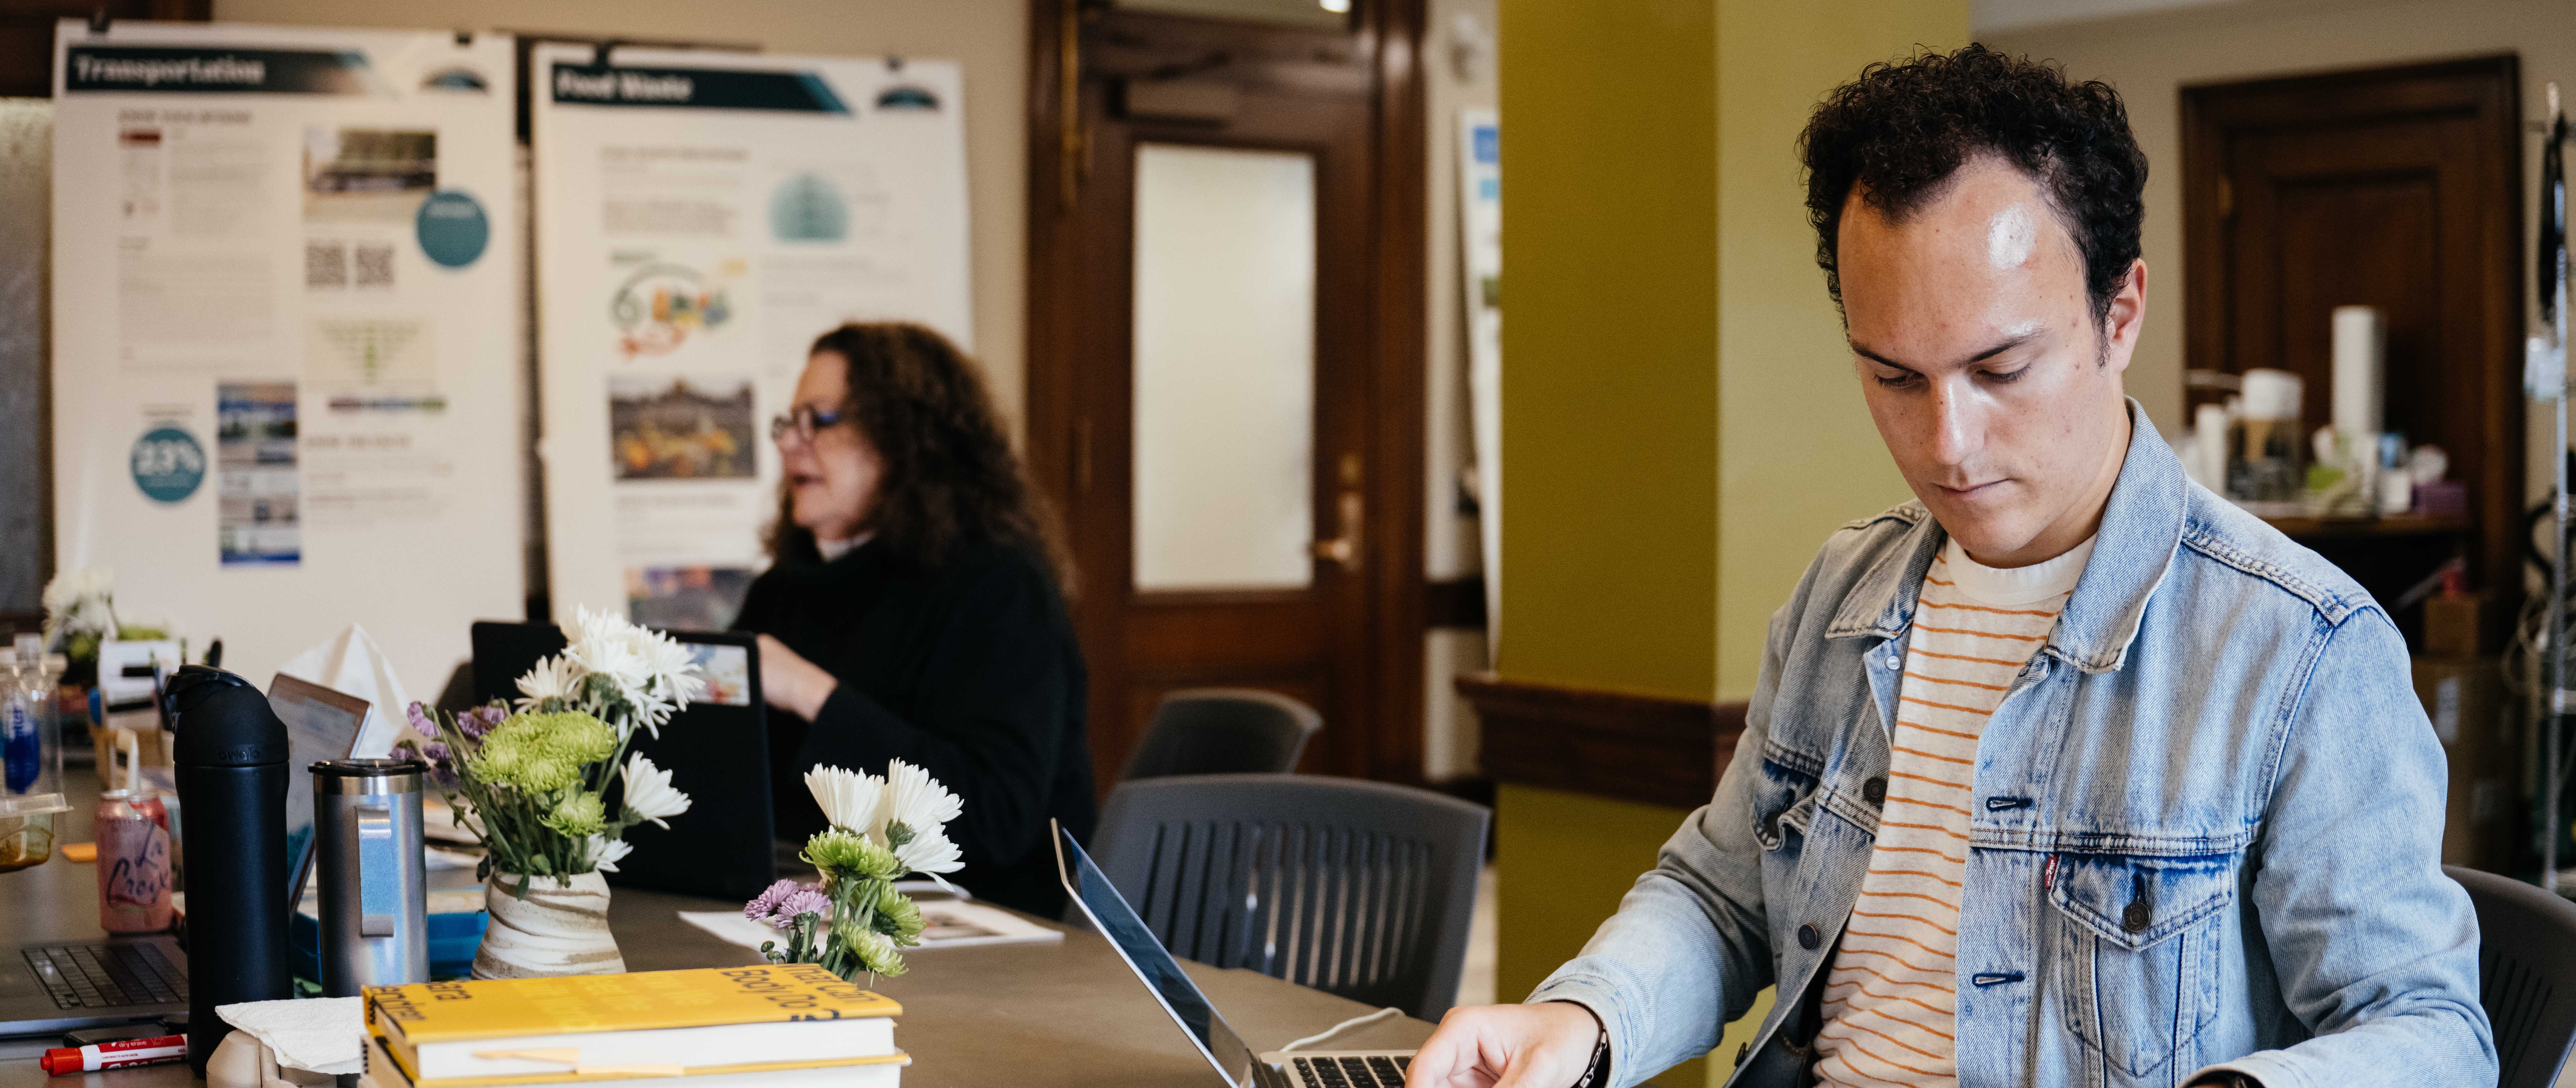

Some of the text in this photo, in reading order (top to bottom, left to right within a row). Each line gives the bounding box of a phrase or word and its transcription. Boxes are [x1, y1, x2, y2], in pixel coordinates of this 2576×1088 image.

[76, 54, 265, 85] Transportation
[557, 71, 693, 101] Food Waste
